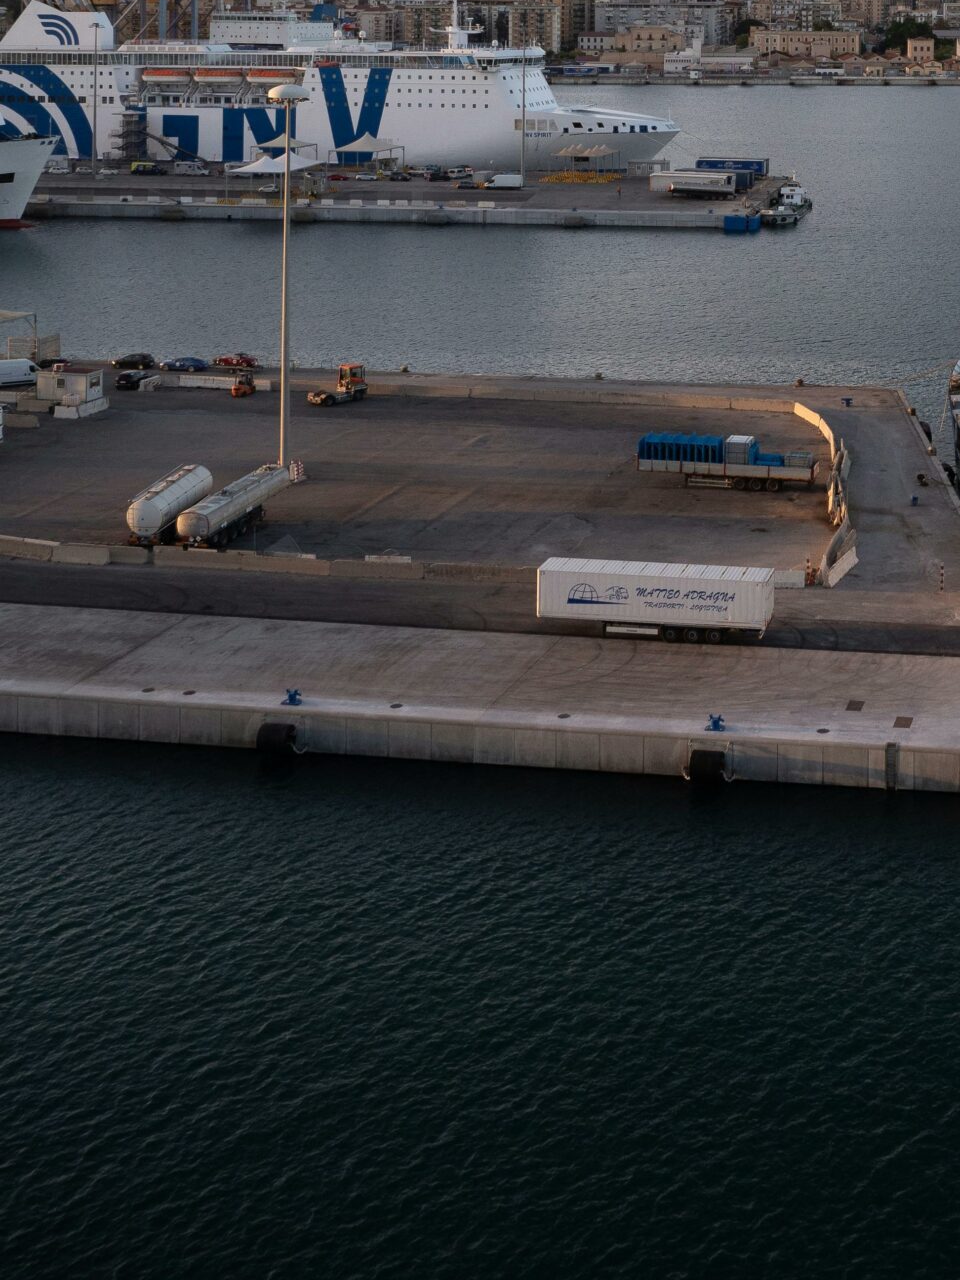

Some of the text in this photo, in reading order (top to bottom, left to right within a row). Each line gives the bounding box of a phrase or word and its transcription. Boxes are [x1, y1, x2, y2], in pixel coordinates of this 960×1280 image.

[635, 587, 736, 604] MATTEO ADRAGNA
[643, 601, 685, 609] TRASPORTI
[689, 604, 728, 613] LOGISTICA
